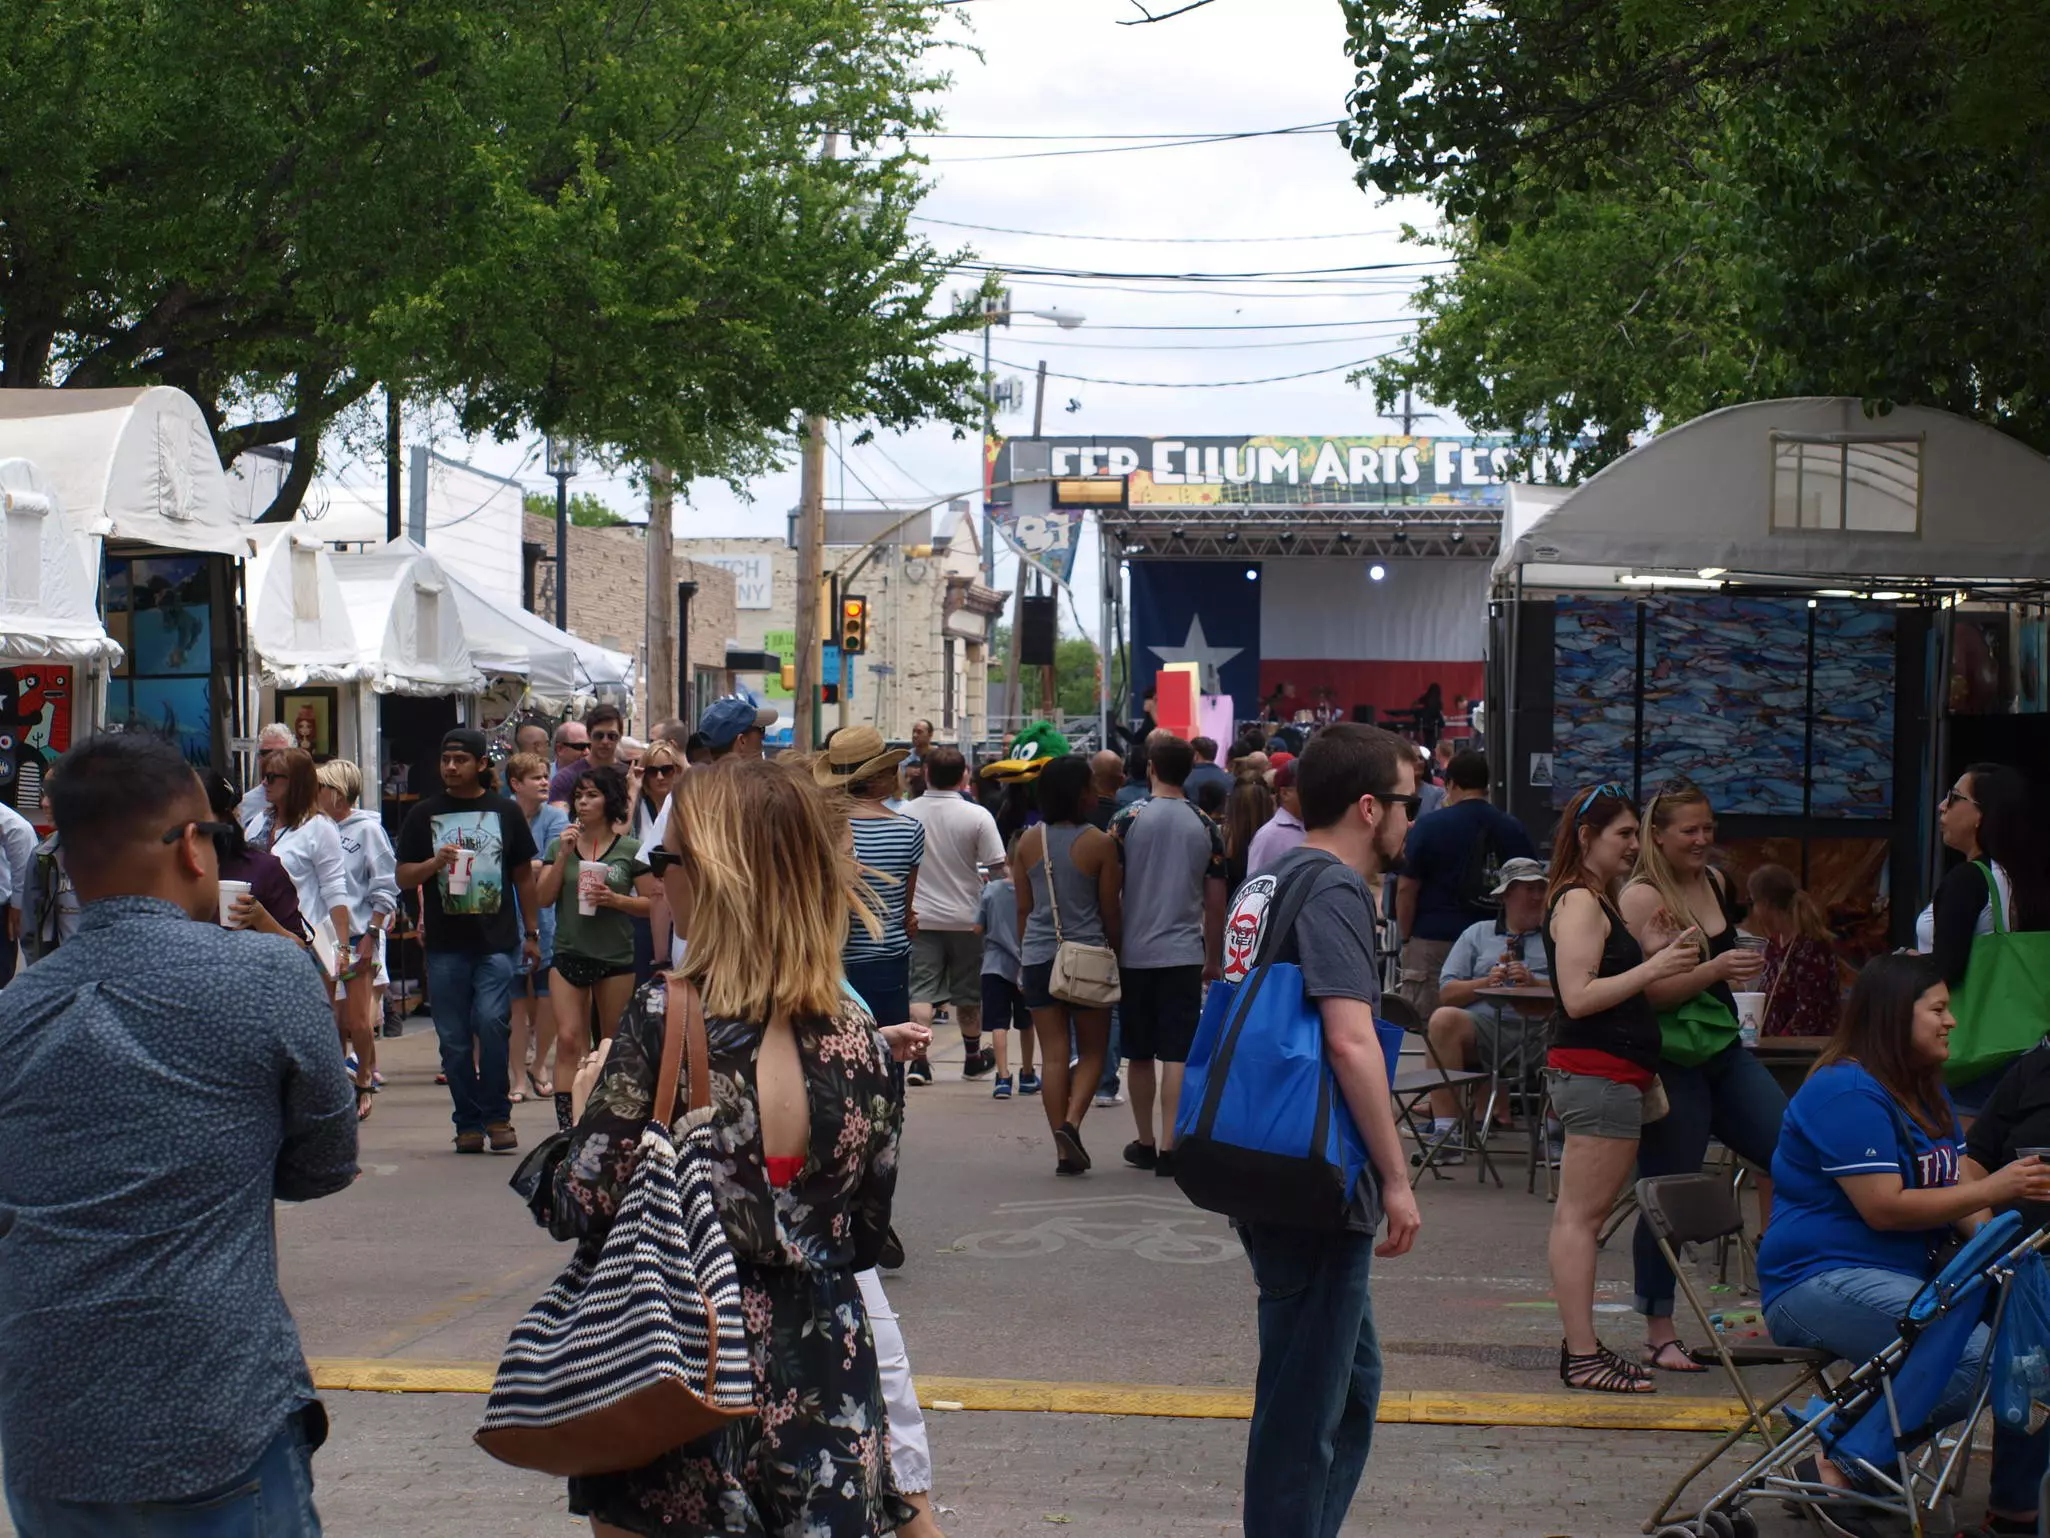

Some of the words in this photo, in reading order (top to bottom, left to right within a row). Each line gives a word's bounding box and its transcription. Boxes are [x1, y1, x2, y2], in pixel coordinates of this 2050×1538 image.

[1051, 446, 1140, 476] EEP
[1152, 441, 1299, 485] ELLUM
[1310, 441, 1420, 485] ARTS
[714, 559, 760, 579] TCH
